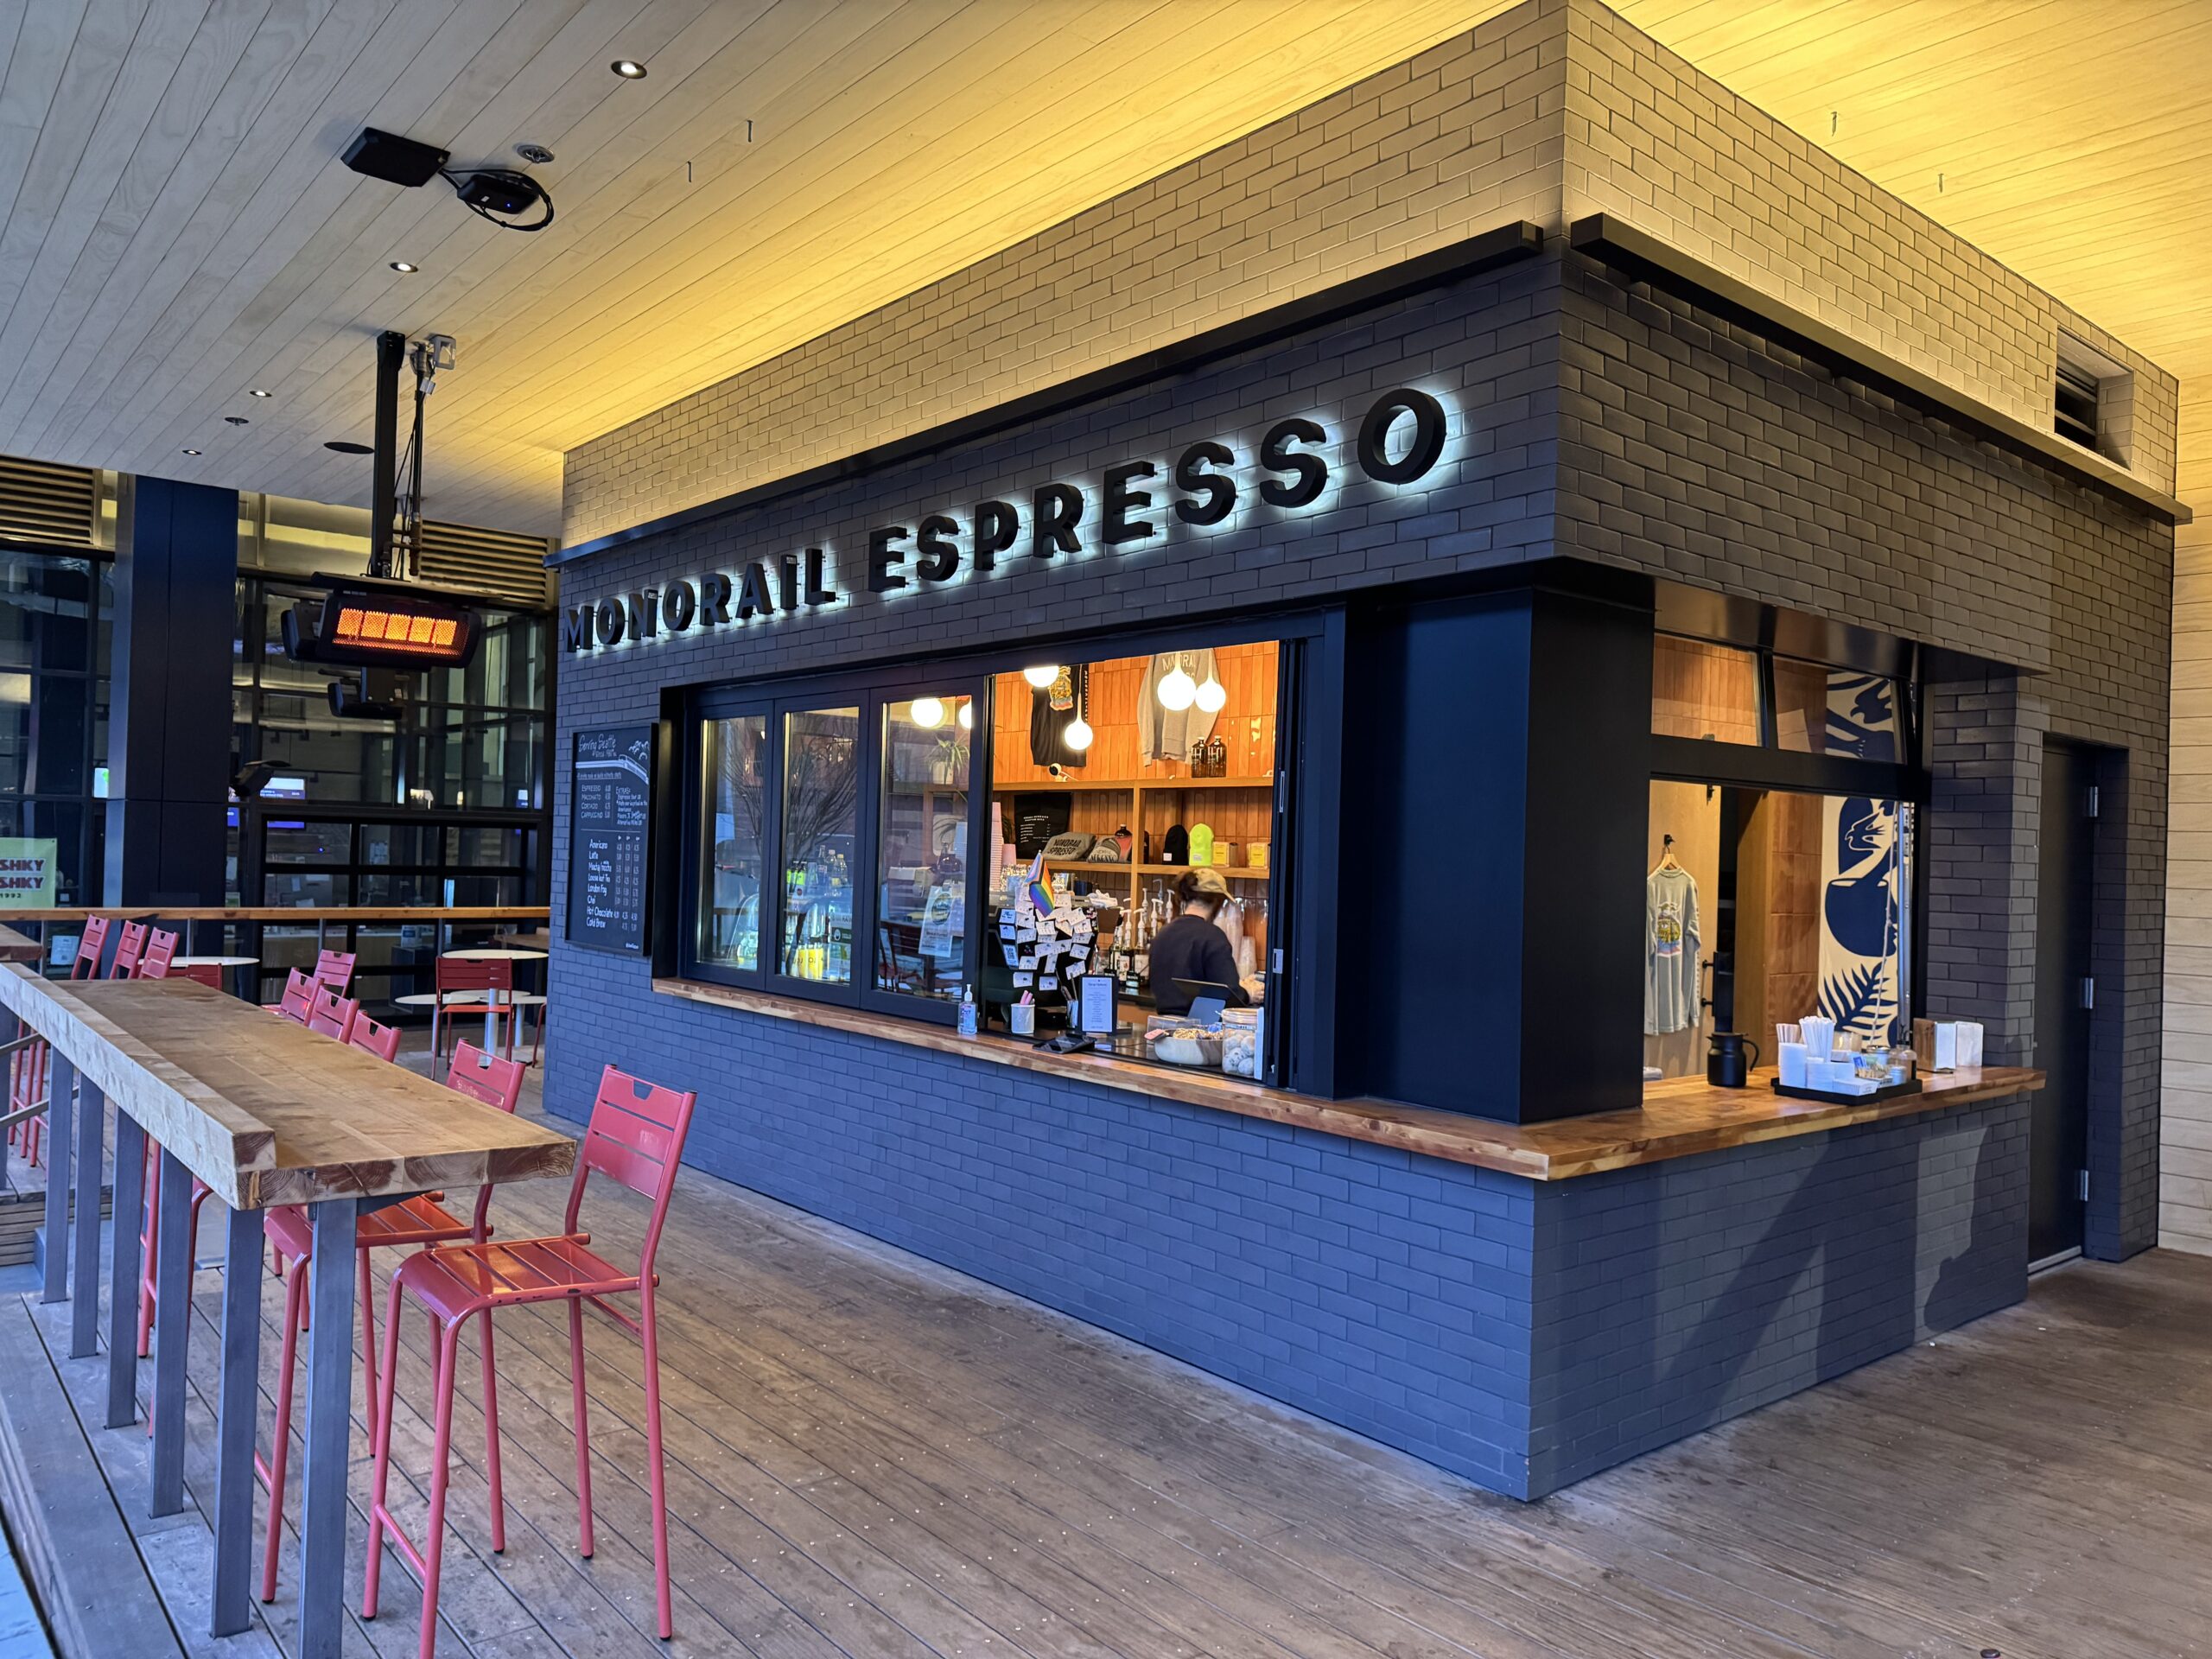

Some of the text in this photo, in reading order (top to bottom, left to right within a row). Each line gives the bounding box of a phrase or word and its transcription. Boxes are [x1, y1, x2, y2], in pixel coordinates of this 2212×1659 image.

[565, 386, 1448, 654] MONORAIL ESPRESSO
[589, 839, 607, 849] Americano
[588, 851, 598, 860] Latte
[0, 859, 44, 871] SHKY
[0, 877, 44, 888] SHKY
[588, 883, 600, 893] London
[594, 906, 613, 918] Chocolate
[587, 917, 595, 927] Cold
[596, 918, 606, 928] Brew
